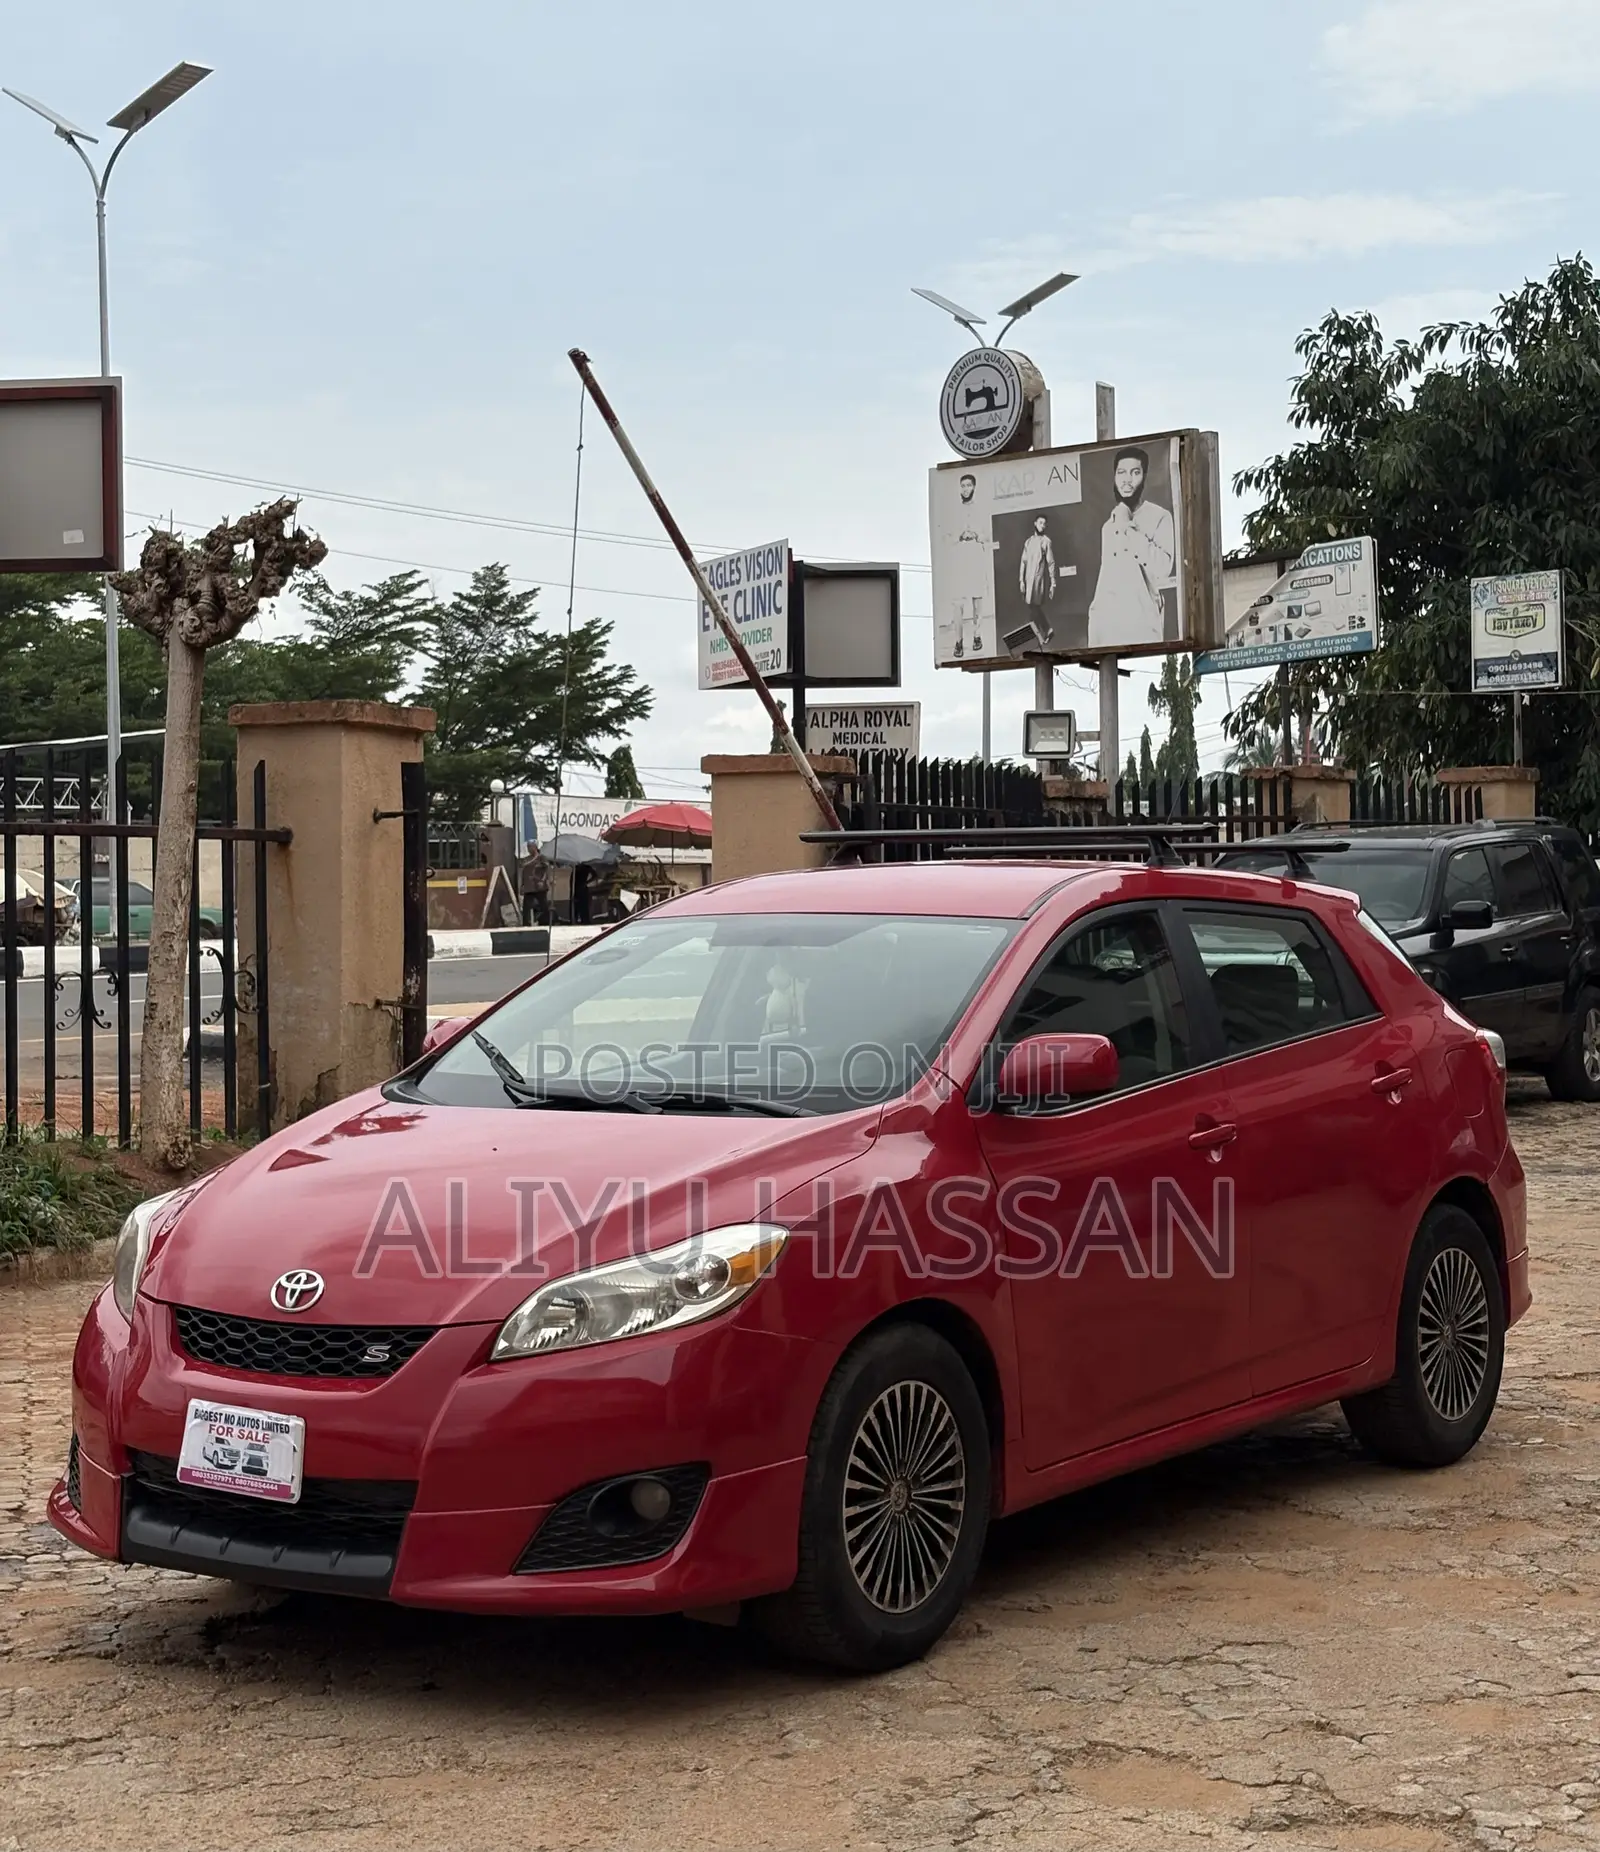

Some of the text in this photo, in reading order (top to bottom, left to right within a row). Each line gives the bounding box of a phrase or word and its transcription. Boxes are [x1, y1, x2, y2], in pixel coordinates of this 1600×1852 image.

[948, 352, 1015, 390] PREMIUM QUALITY
[954, 425, 1009, 452] TAILOR SHOP
[1047, 462, 1079, 486] AN
[744, 544, 783, 583] VISION
[1291, 575, 1331, 589] ACCESSORIES
[733, 579, 783, 625] CLINIC
[709, 626, 773, 655] NHIS OVIDER
[1314, 635, 1359, 648] Entrance
[770, 647, 782, 670] 20
[810, 709, 912, 729] ALPHA ROYAL
[832, 731, 887, 745] MEDICAL
[362, 1345, 392, 1363] S
[208, 1423, 270, 1445] FOR SALE
[224, 1413, 236, 1426] MO
[236, 1415, 261, 1430] AUTOS
[261, 1419, 290, 1435] LIMITED
